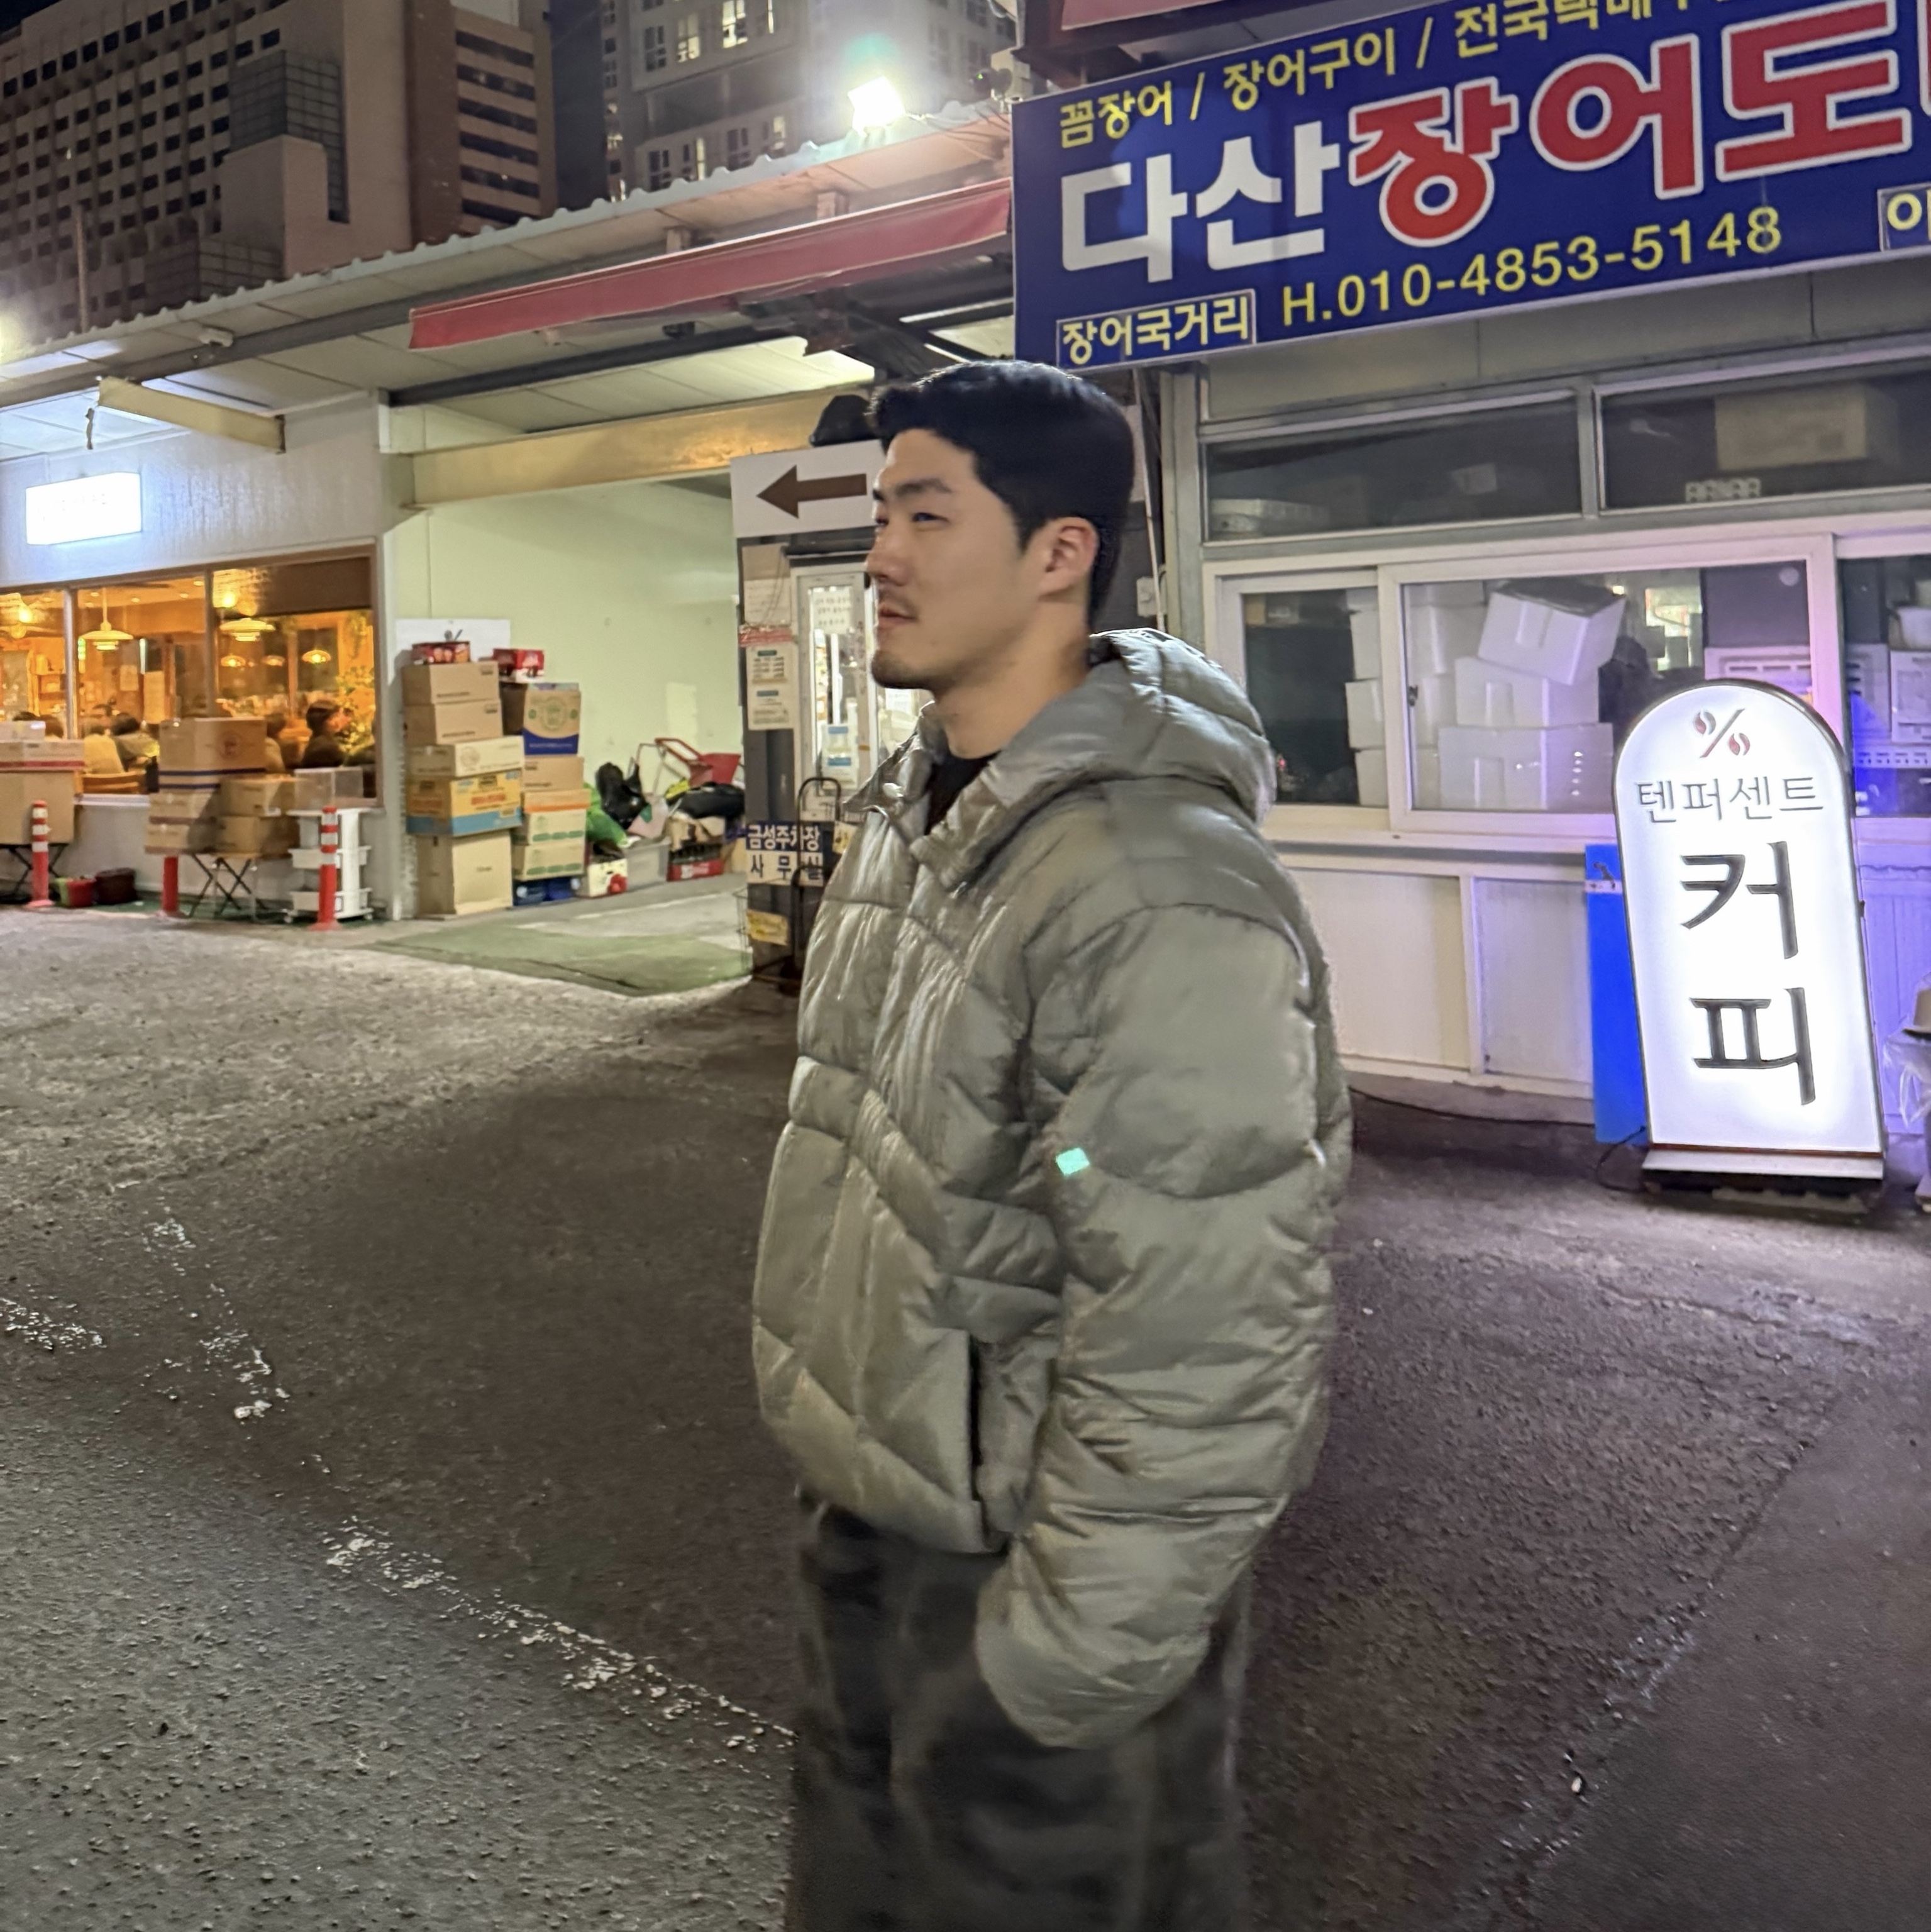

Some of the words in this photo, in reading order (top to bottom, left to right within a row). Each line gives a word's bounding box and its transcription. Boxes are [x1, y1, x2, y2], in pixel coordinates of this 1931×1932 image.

[1060, 81, 1173, 148] 꼼장어
[1224, 28, 1395, 111] 장어구이
[1348, 0, 1931, 247] 장어도
[1283, 206, 1782, 326] H.010-4853-5148
[1063, 296, 1248, 364] 장어국거리
[748, 824, 820, 851] 금성주차장
[1636, 776, 1824, 823] 텐퍼센트
[1679, 841, 1816, 1106] 커피
